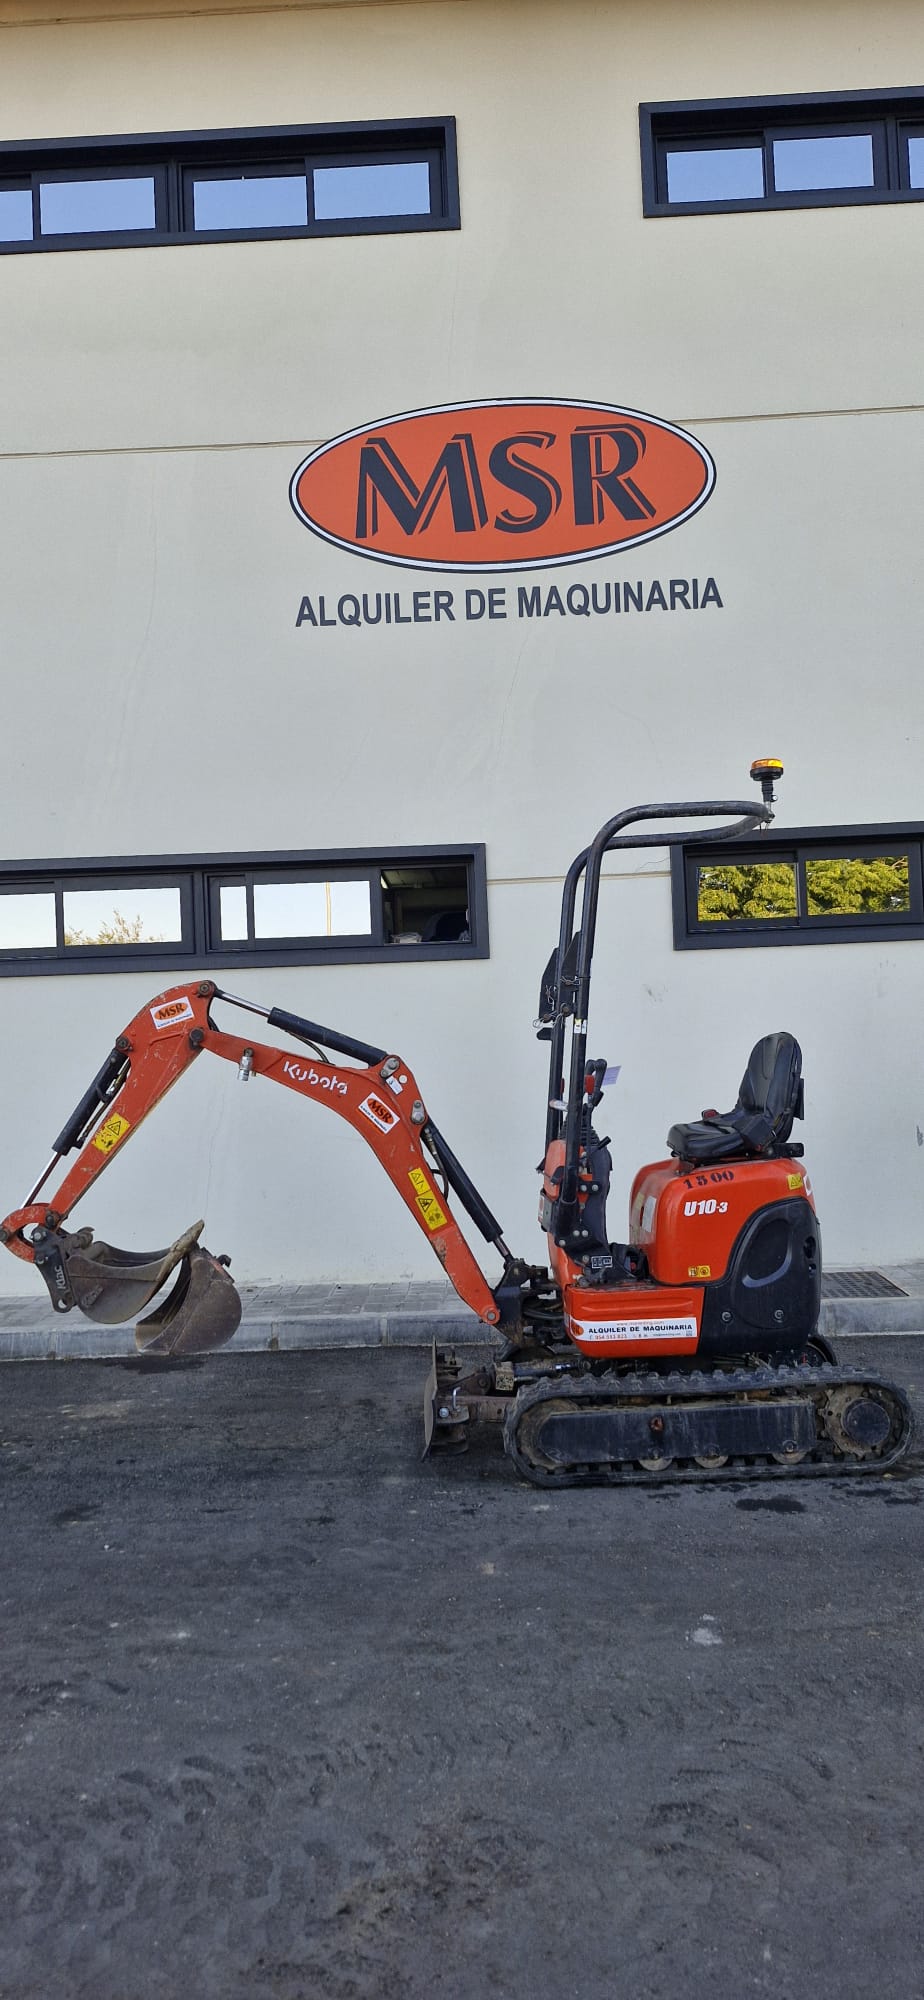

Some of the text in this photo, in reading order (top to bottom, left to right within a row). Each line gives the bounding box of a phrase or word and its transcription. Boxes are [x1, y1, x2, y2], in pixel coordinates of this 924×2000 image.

[355, 423, 657, 538] MSR
[295, 577, 724, 628] ALQUILER DE MAQUINARIA
[159, 1003, 184, 1019] MSR
[283, 1060, 348, 1095] Kubota
[369, 1100, 393, 1123] MSR
[684, 1199, 728, 1217] U10-3
[588, 1326, 627, 1334] ALQUILER
[643, 1324, 693, 1332] MAQUINARIA
